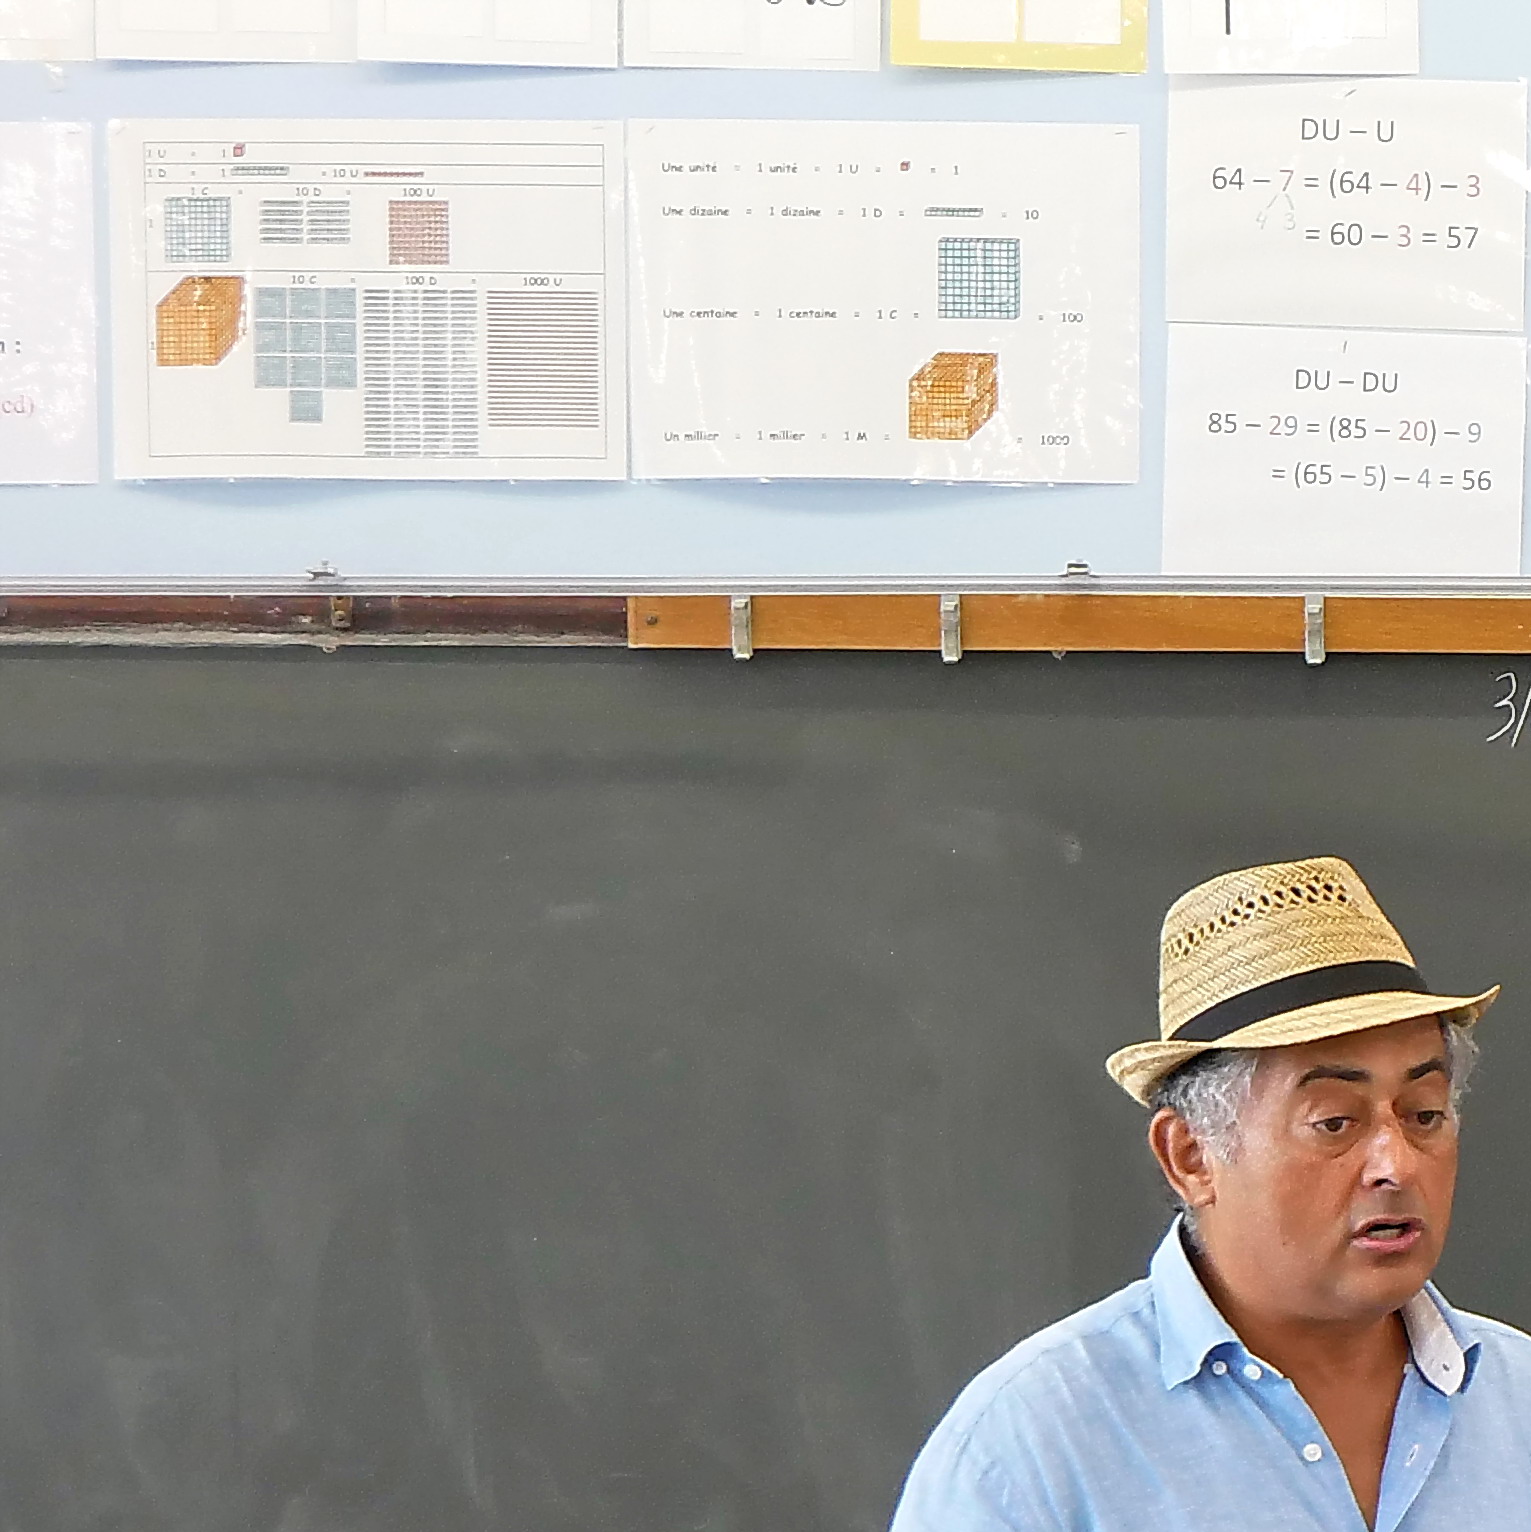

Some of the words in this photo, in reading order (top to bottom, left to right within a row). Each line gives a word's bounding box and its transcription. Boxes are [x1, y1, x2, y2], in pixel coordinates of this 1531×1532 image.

[1301, 117, 1340, 142] DU
[1376, 120, 1395, 143] U
[661, 162, 684, 173] Une
[688, 161, 718, 173] unité
[768, 161, 798, 174] unité
[1212, 166, 1246, 191] 64
[1279, 169, 1295, 193] 7
[1303, 177, 1320, 188] =
[1329, 168, 1373, 199] (64
[1405, 170, 1432, 202] 4)
[1466, 174, 1481, 198] 3
[661, 206, 684, 217] Une
[689, 205, 730, 217] dizaine
[780, 205, 822, 218] dizaine
[1305, 229, 1321, 240] =
[1330, 222, 1363, 247] 60
[1396, 224, 1412, 248] 3
[1421, 232, 1438, 243] =
[1446, 225, 1479, 250] 57
[662, 308, 685, 319] Une
[689, 308, 738, 319] centaine
[788, 307, 838, 319] centaine
[1295, 368, 1331, 391] DU
[1362, 371, 1399, 394] DU
[683, 430, 720, 442] millier
[769, 429, 806, 441] millier
[1207, 412, 1238, 434] 85
[1268, 415, 1298, 437] 29
[1306, 423, 1320, 433] =
[1329, 415, 1367, 443] (85
[1398, 419, 1437, 447] 20)
[1467, 422, 1482, 444] 9
[1271, 468, 1286, 479] =
[1294, 461, 1332, 489] (65
[1363, 464, 1386, 492] 5)
[1416, 468, 1432, 489] 4
[1439, 475, 1454, 485] =
[1461, 469, 1492, 491] 56
